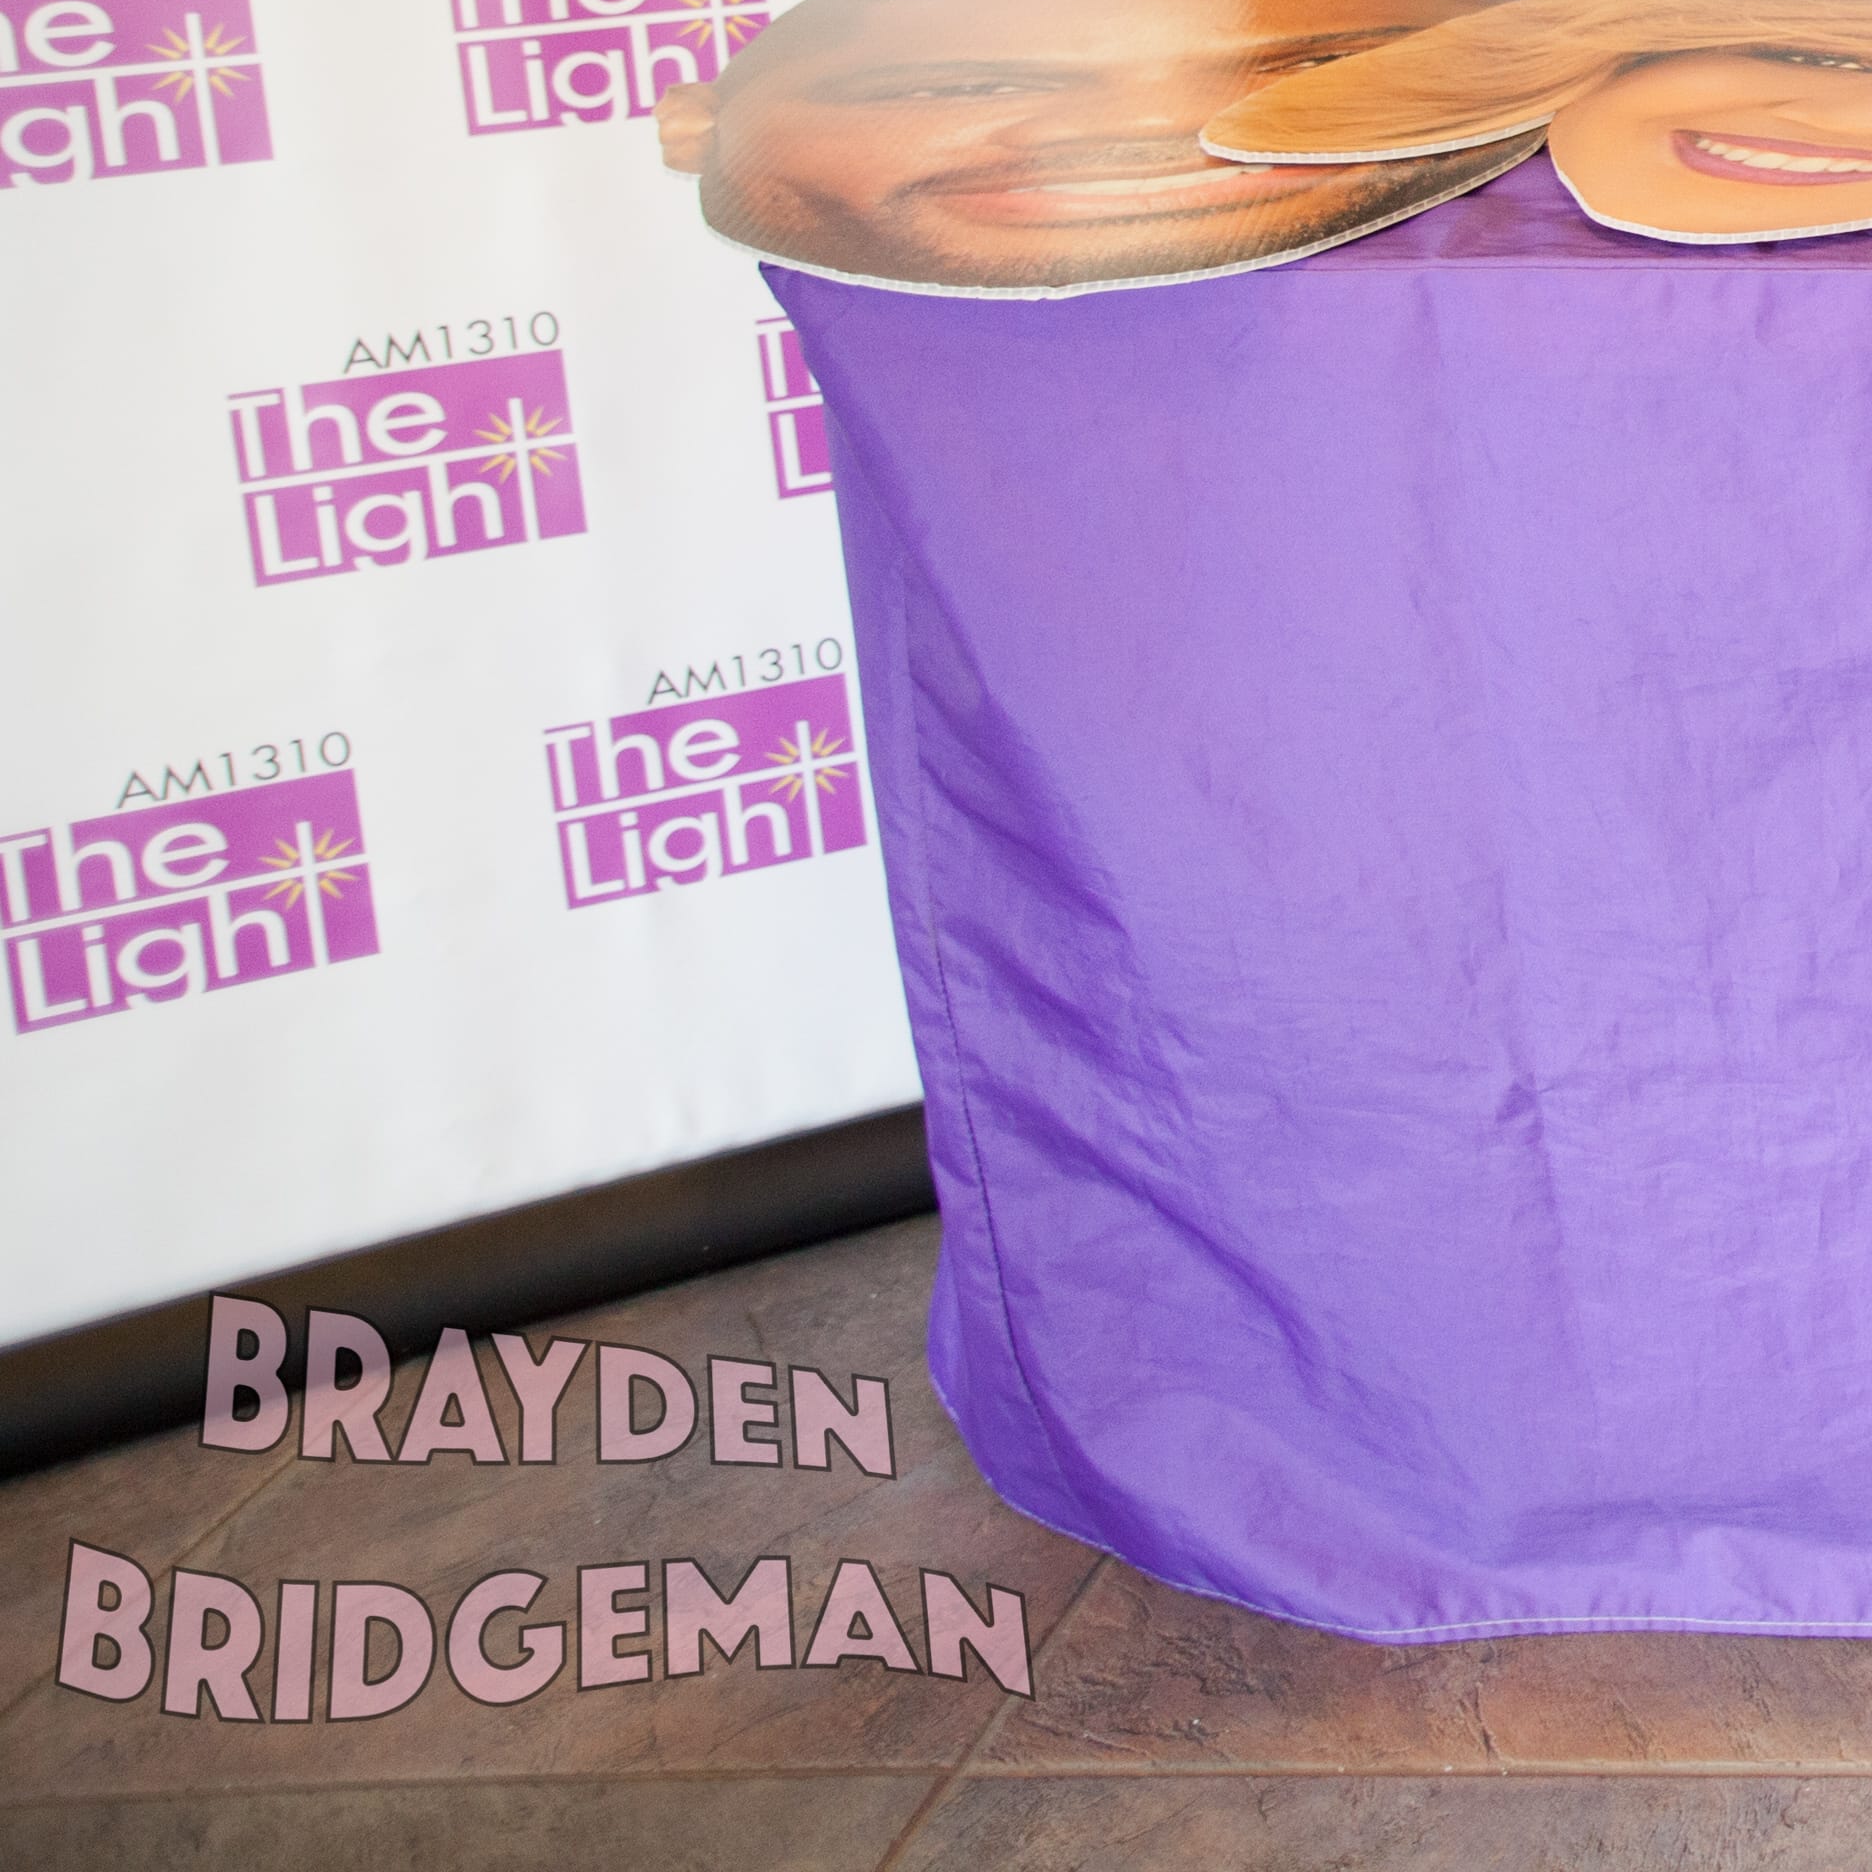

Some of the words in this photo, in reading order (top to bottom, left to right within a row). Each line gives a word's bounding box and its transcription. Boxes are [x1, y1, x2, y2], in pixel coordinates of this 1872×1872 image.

[341, 311, 561, 374] AM1310
[228, 387, 447, 482] The
[252, 397, 540, 580] Light
[646, 638, 843, 704] AM1310
[116, 731, 351, 809] AM1310
[544, 716, 740, 812] The
[564, 721, 825, 905] Light
[0, 820, 230, 924] The
[18, 820, 330, 1023] Light
